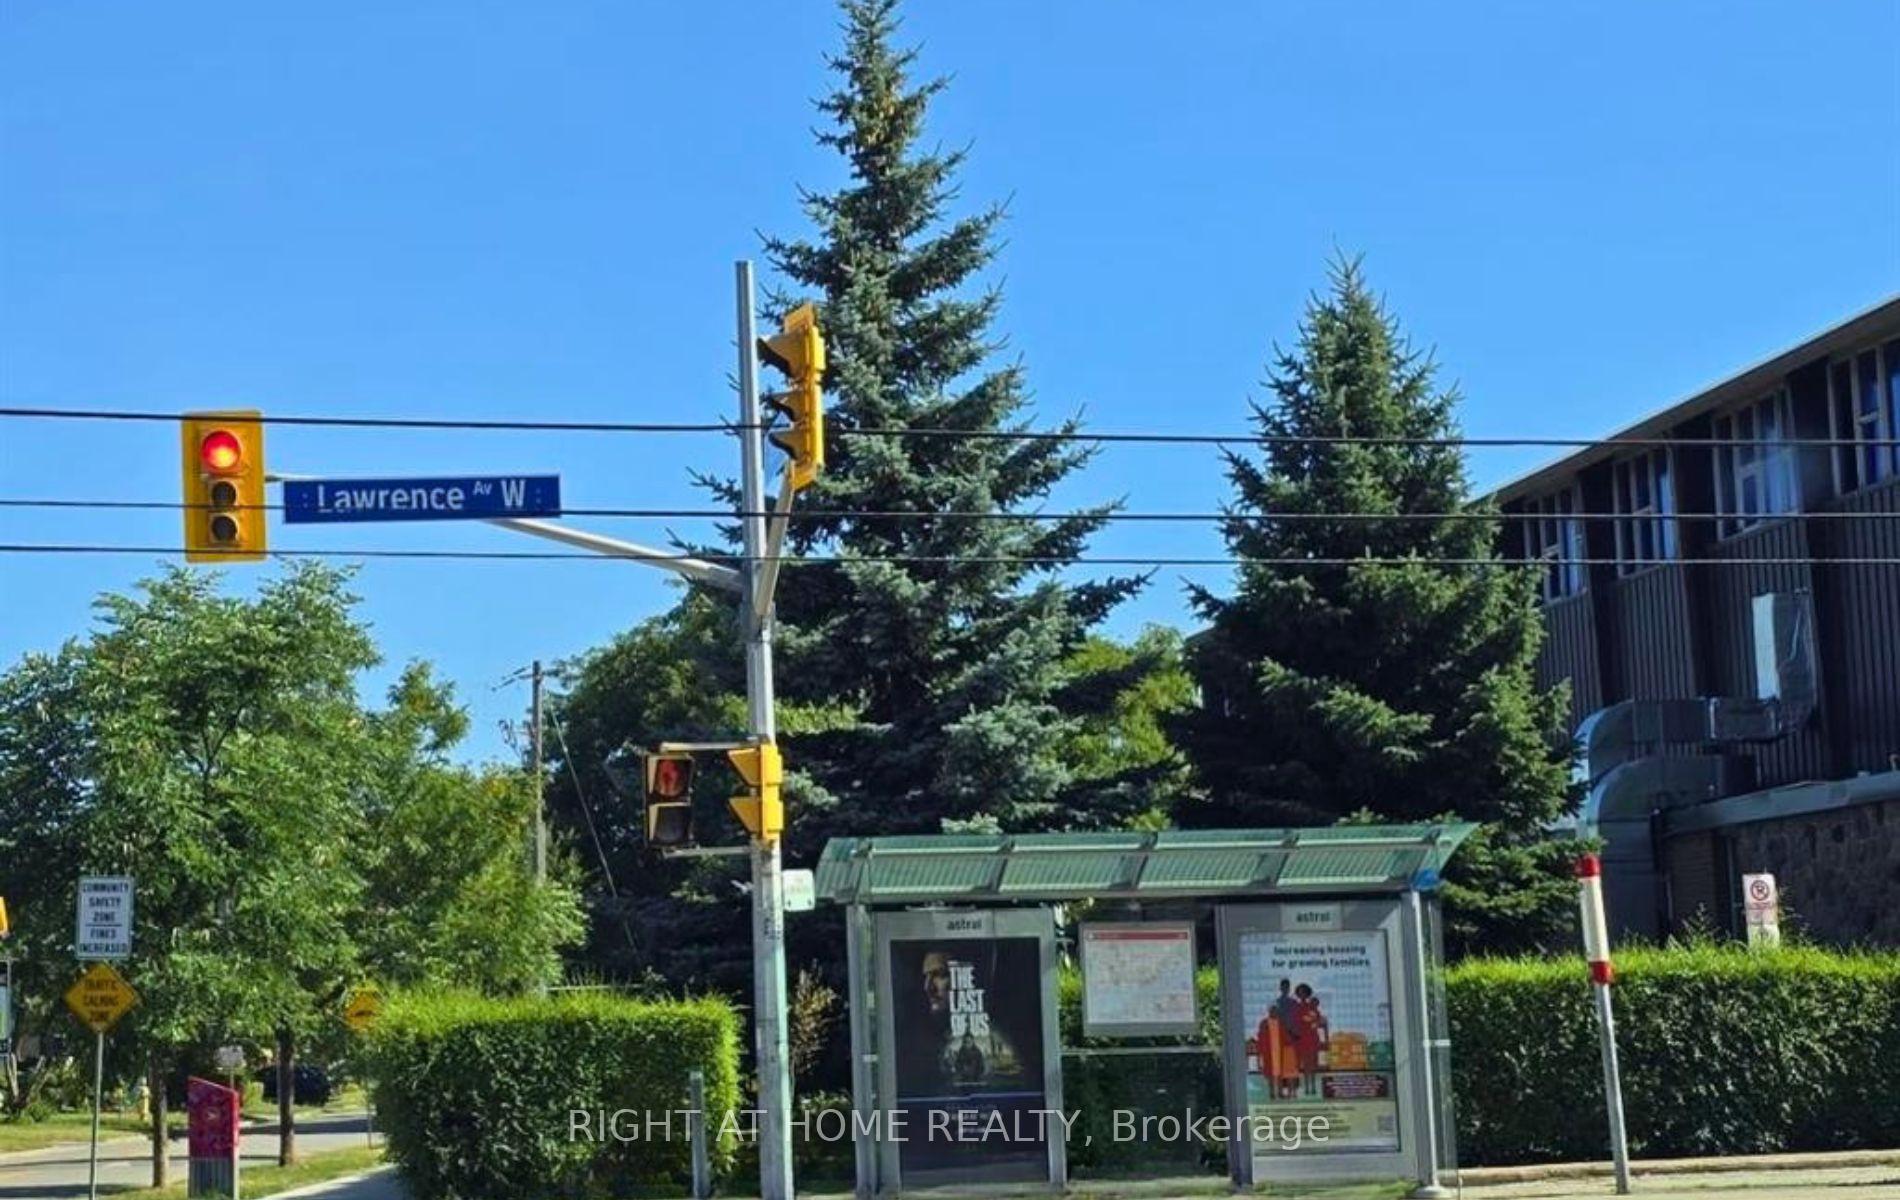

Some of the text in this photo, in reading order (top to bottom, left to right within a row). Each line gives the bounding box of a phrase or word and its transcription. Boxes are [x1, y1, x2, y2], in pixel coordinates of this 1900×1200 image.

[317, 479, 526, 512] Lawrence Av W
[89, 896, 121, 907] SAFETY
[93, 911, 115, 921] ZONE
[1296, 911, 1331, 922] astral
[947, 918, 982, 930] astral
[90, 928, 116, 939] FINES
[80, 943, 128, 953] INCREASED
[948, 966, 975, 989] THE
[949, 989, 985, 1013] LAST
[951, 1012, 990, 1037] OF US
